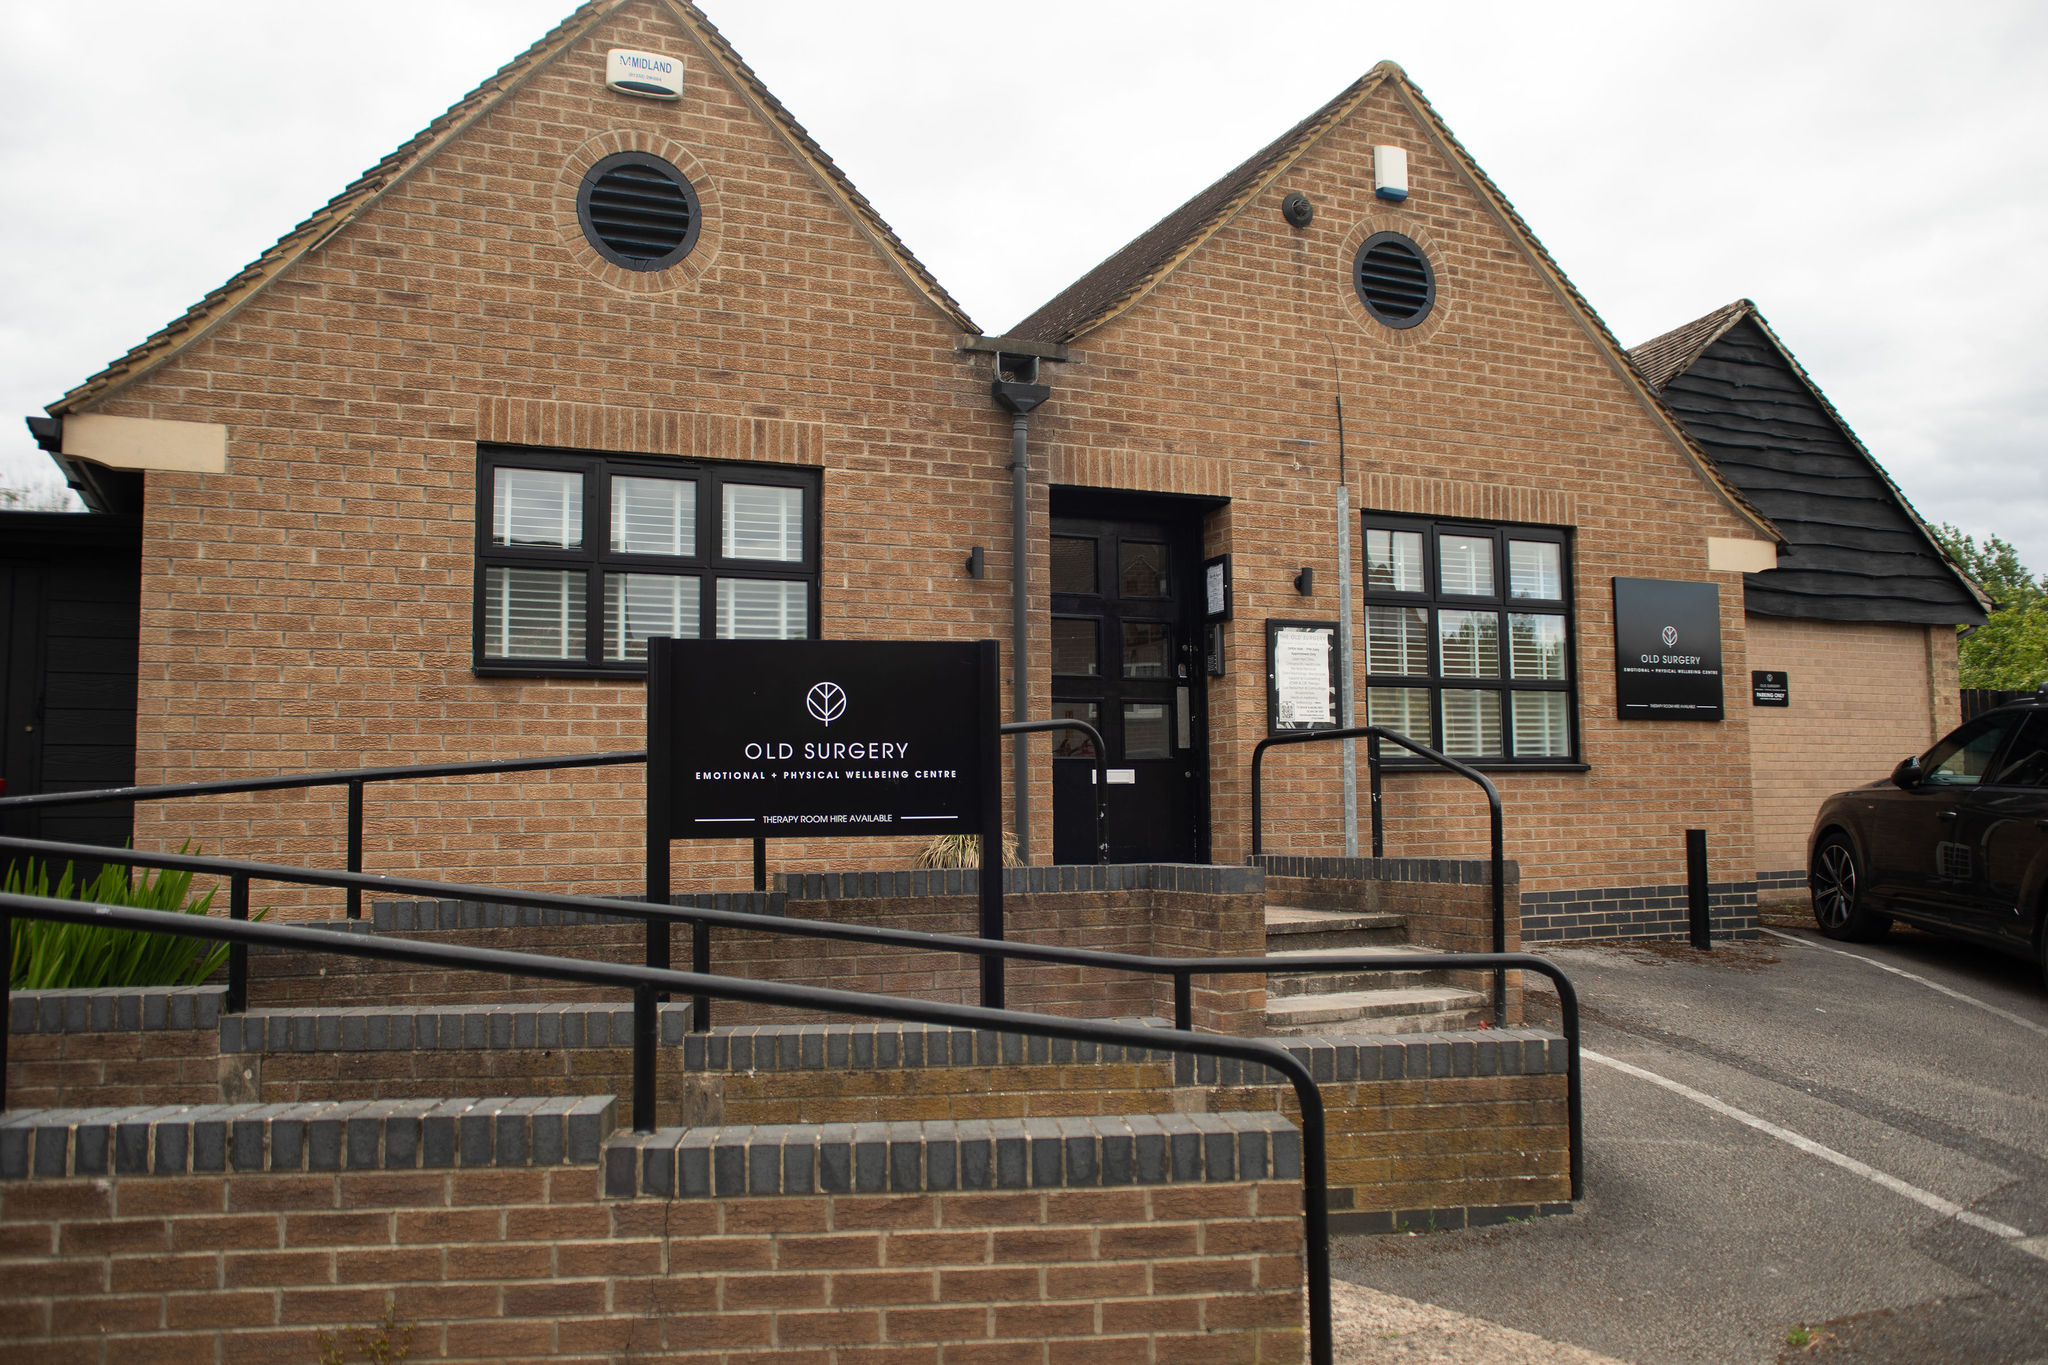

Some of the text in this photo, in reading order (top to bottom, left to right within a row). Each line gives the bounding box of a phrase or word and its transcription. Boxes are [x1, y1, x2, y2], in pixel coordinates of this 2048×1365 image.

[632, 56, 672, 74] MIDLAND
[1640, 654, 1700, 664] OLD SURGERY
[744, 742, 909, 760] OLD SURGERY
[695, 771, 766, 780] EMOTIONAL
[784, 771, 840, 780] PHYSICAL
[846, 770, 909, 779] WELLBEING
[914, 770, 957, 778] CENTRE
[762, 814, 893, 824] THERAPY ROOM HIRE AVAILABLE
